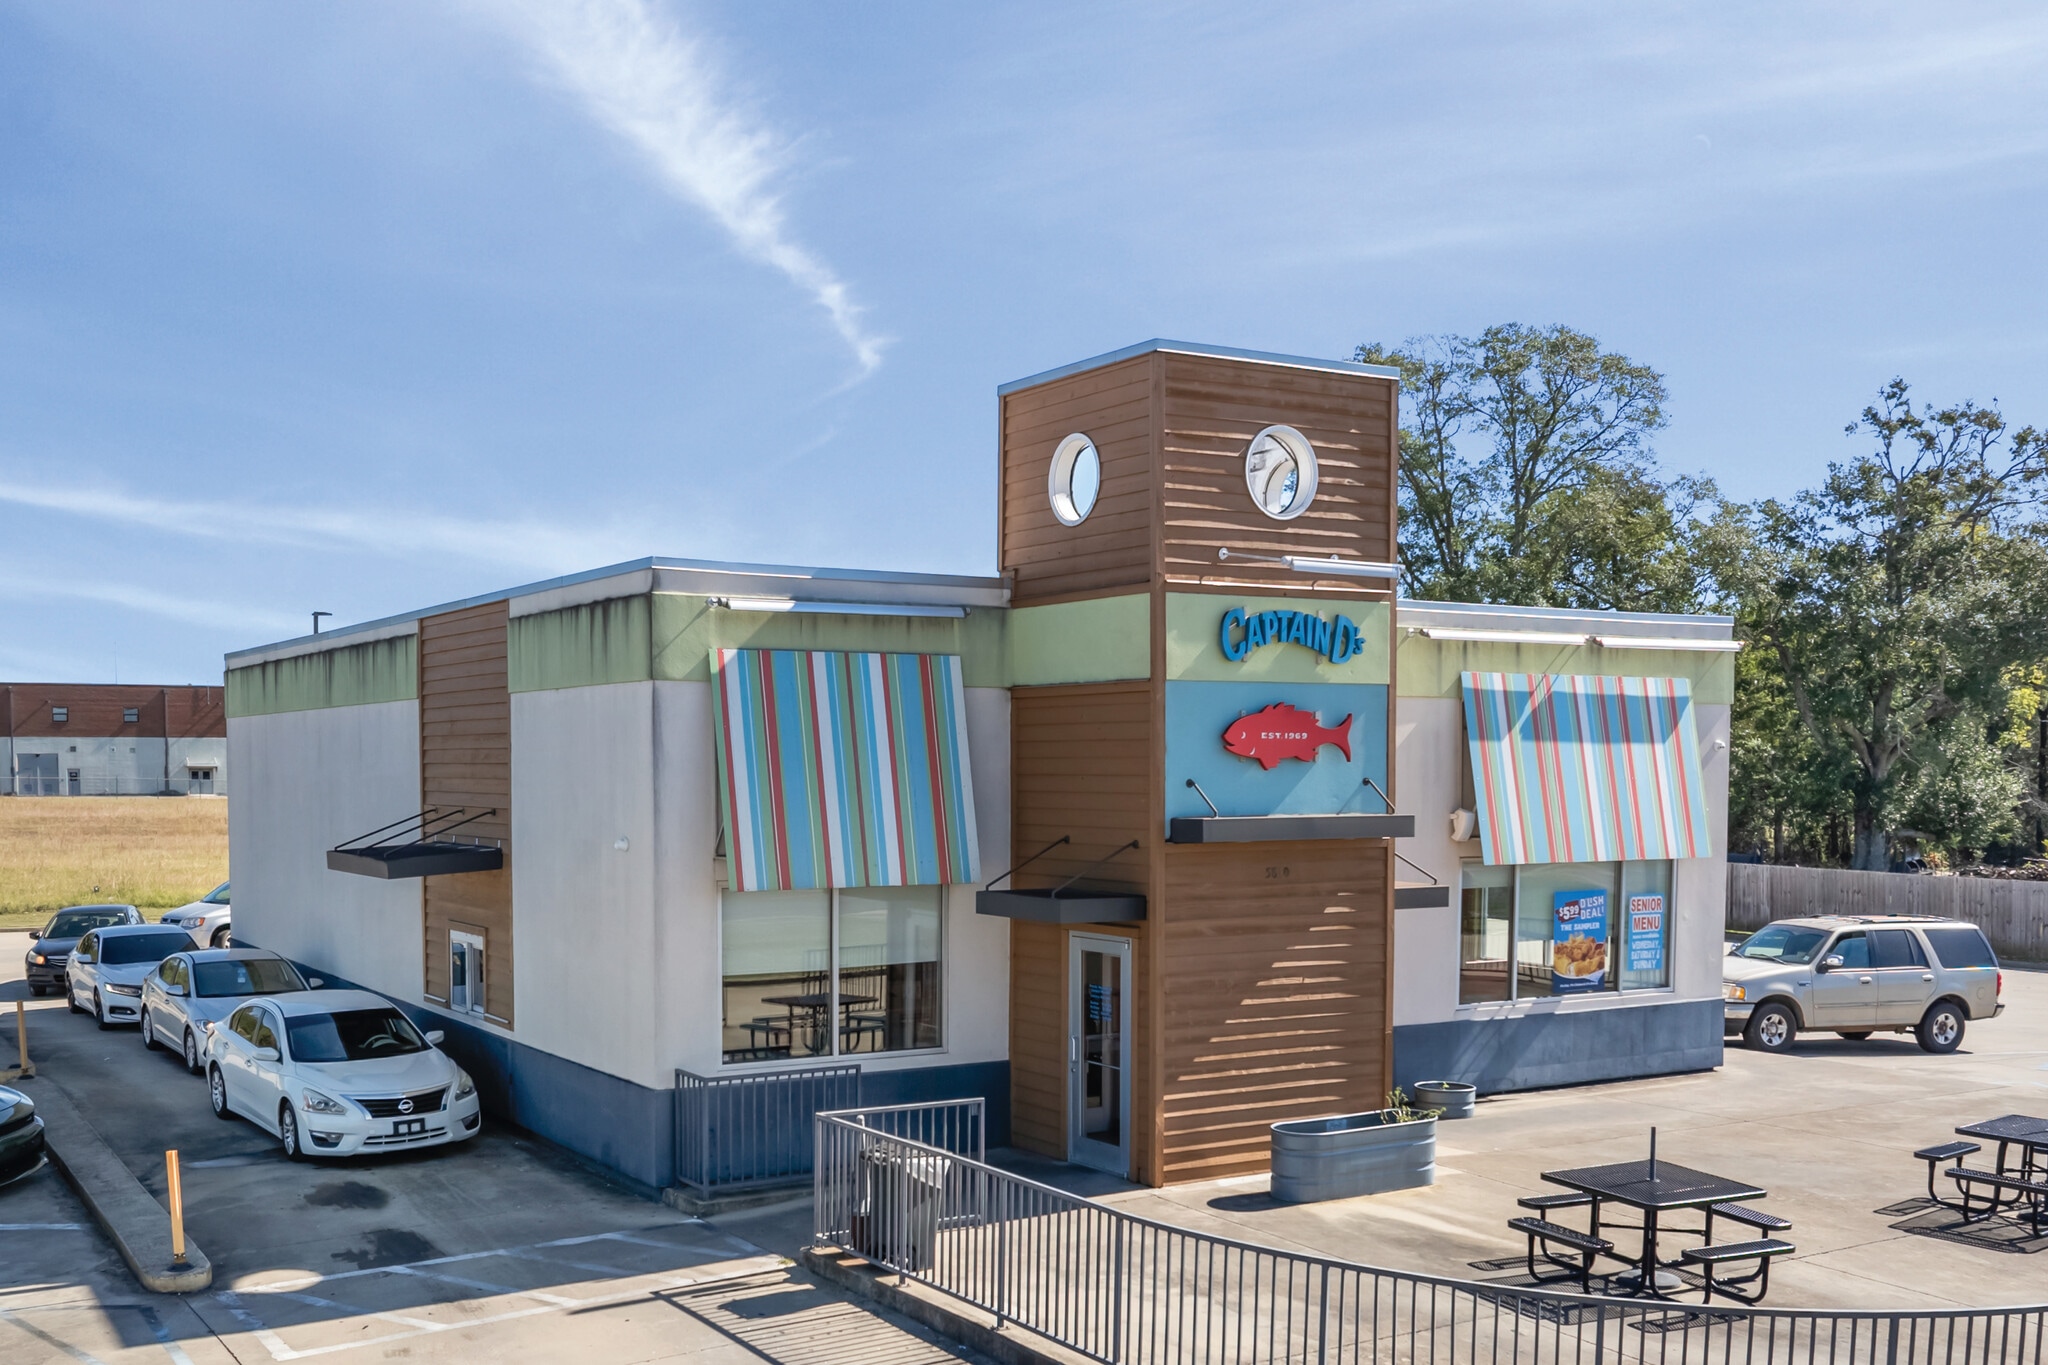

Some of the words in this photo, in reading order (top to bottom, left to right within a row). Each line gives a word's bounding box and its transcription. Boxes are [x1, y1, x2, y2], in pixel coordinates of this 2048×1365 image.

[1221, 607, 1332, 662] CAPTAIN
[1284, 732, 1308, 740] 1969
[1631, 898, 1662, 912] SENIOR
[1580, 906, 1605, 920] DEAL!
[1560, 923, 1572, 931] THE
[1573, 921, 1600, 931] SAMPLER
[1633, 916, 1660, 930] MENU
